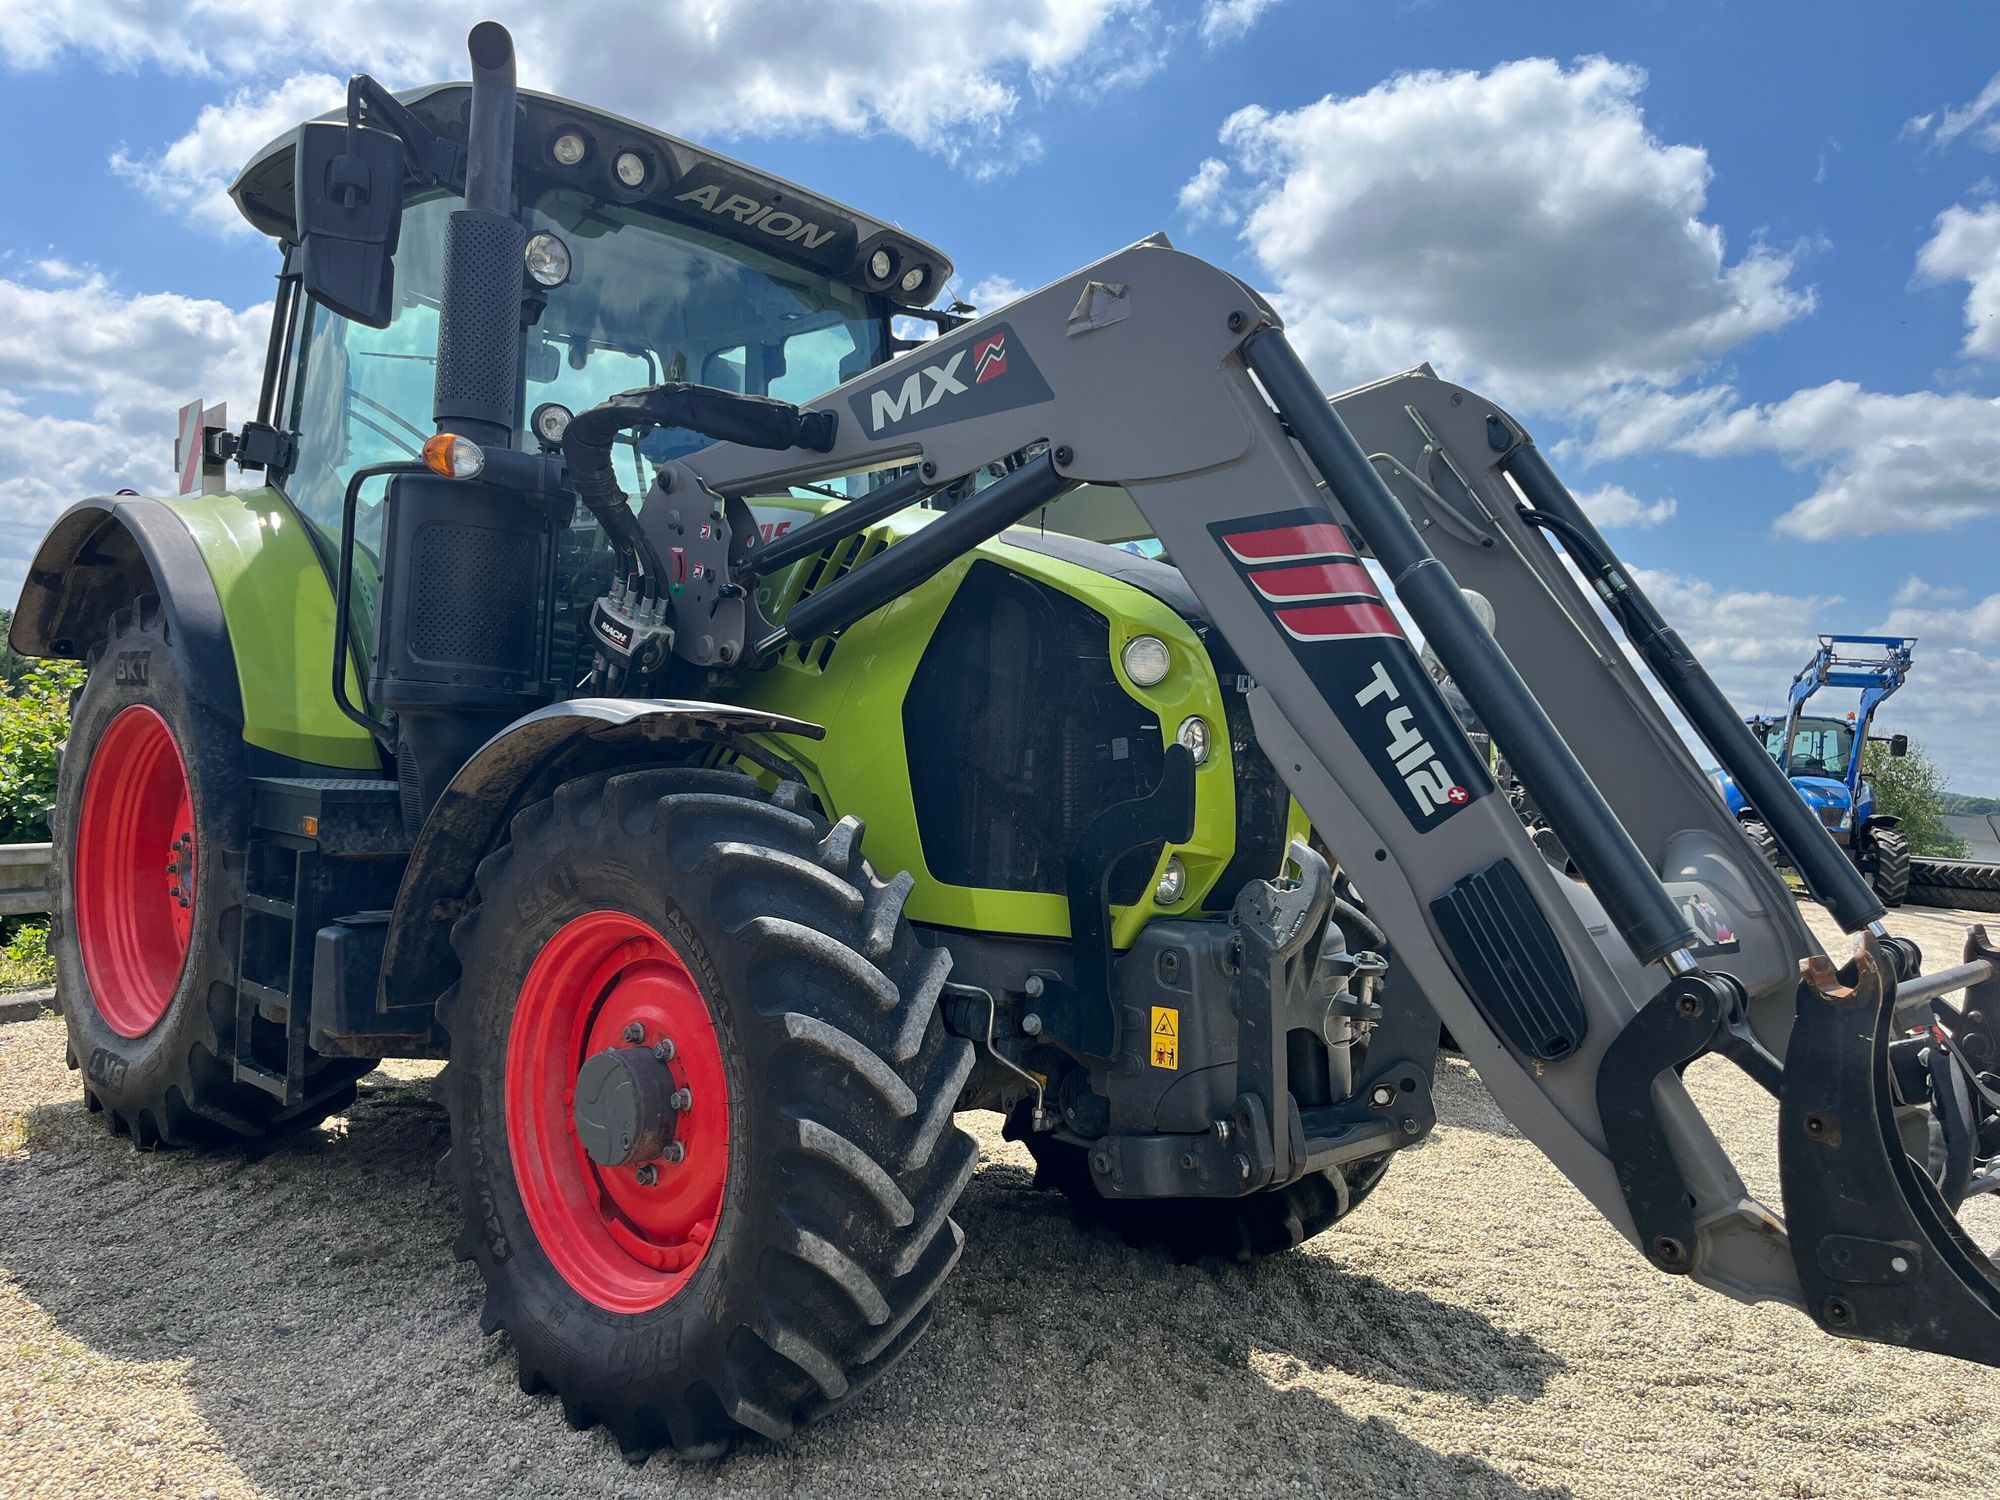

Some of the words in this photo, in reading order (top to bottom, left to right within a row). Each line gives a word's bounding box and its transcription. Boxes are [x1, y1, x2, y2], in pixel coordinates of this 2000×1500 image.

[674, 184, 836, 250] ARION
[871, 350, 968, 432] MX
[601, 621, 628, 642] MACH
[117, 658, 148, 680] BKT
